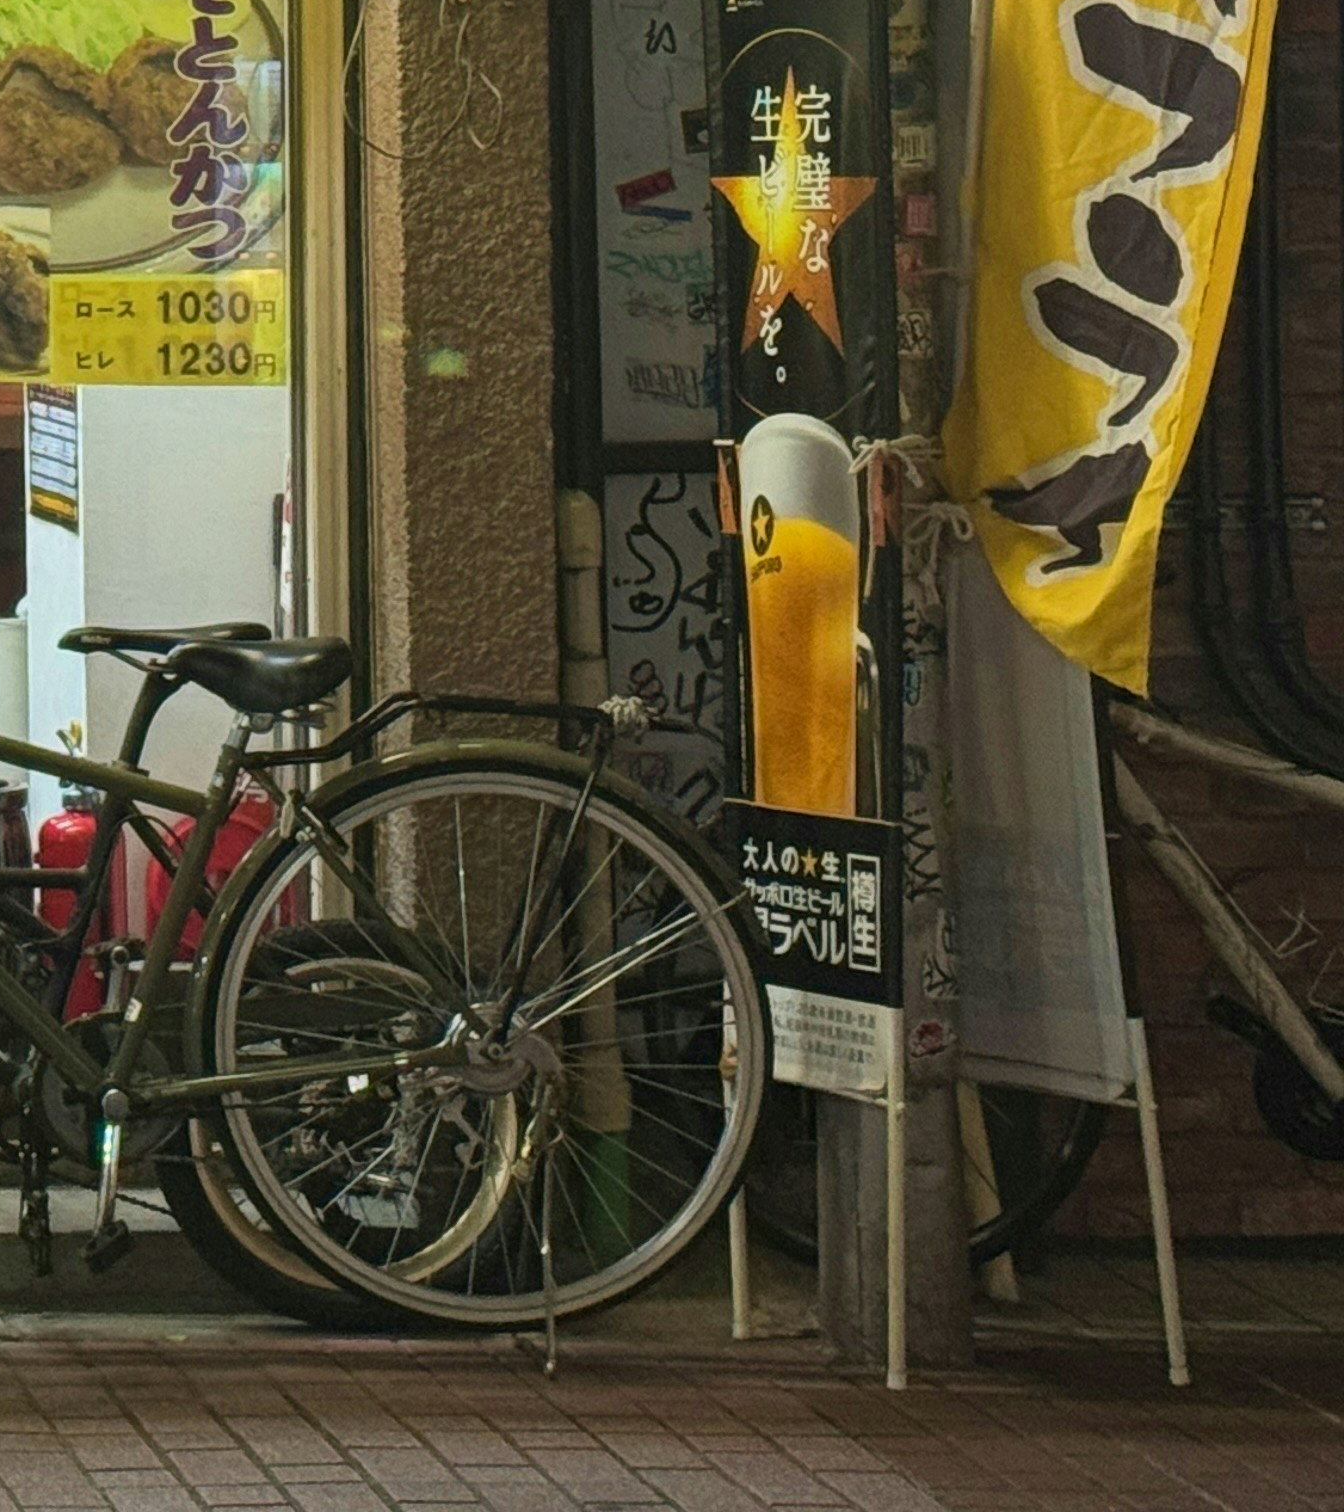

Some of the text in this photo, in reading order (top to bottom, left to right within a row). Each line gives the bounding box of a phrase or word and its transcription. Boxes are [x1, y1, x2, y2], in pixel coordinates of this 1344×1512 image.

[794, 85, 832, 273] 完璧な
[75, 290, 277, 325] ロース 1030円
[75, 341, 277, 378] ヒレ 1230円
[851, 869, 878, 957] 樽生
